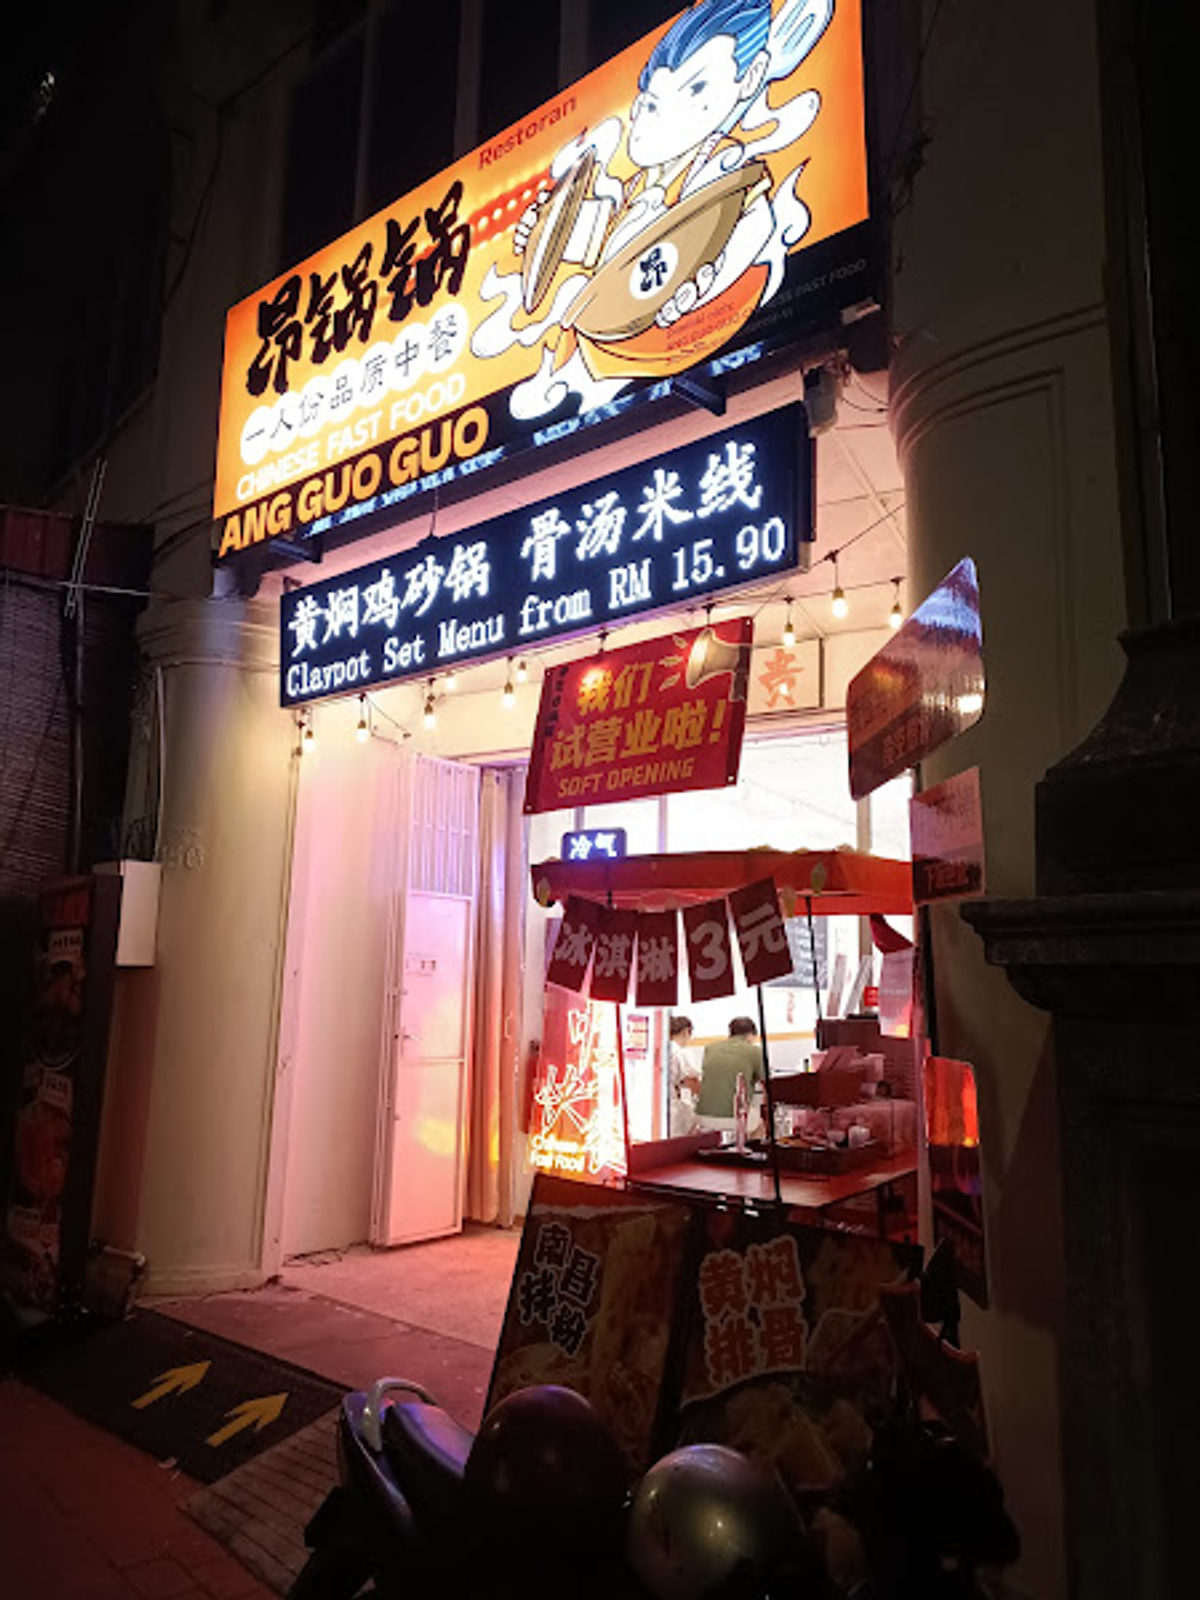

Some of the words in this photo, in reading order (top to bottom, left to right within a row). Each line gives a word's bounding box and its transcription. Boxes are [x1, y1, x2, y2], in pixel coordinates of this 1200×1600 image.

[478, 96, 576, 170] Restoran
[246, 180, 471, 396] 昂锅锅
[246, 315, 457, 442] 一人份品质中餐
[218, 492, 292, 558] ANG
[297, 453, 382, 524] GUO
[388, 405, 489, 486] GUO
[236, 440, 320, 500] CHINESE
[326, 411, 383, 461] FAST
[389, 373, 466, 431] FOOD
[288, 541, 491, 657] 黄焖鸡砂锅
[519, 440, 764, 582] 骨汤米线
[286, 649, 371, 697] Claypot
[383, 634, 426, 673] Set
[437, 613, 505, 658] Menu
[518, 589, 593, 635] from
[608, 558, 652, 609] RM
[672, 516, 786, 591] 15.90
[577, 662, 654, 716] 我们
[557, 772, 603, 799] SOFT
[606, 757, 696, 790] OPENING
[569, 833, 617, 860] 冷气
[700, 1236, 806, 1321] 黄焖
[705, 1305, 809, 1386] 排骨
